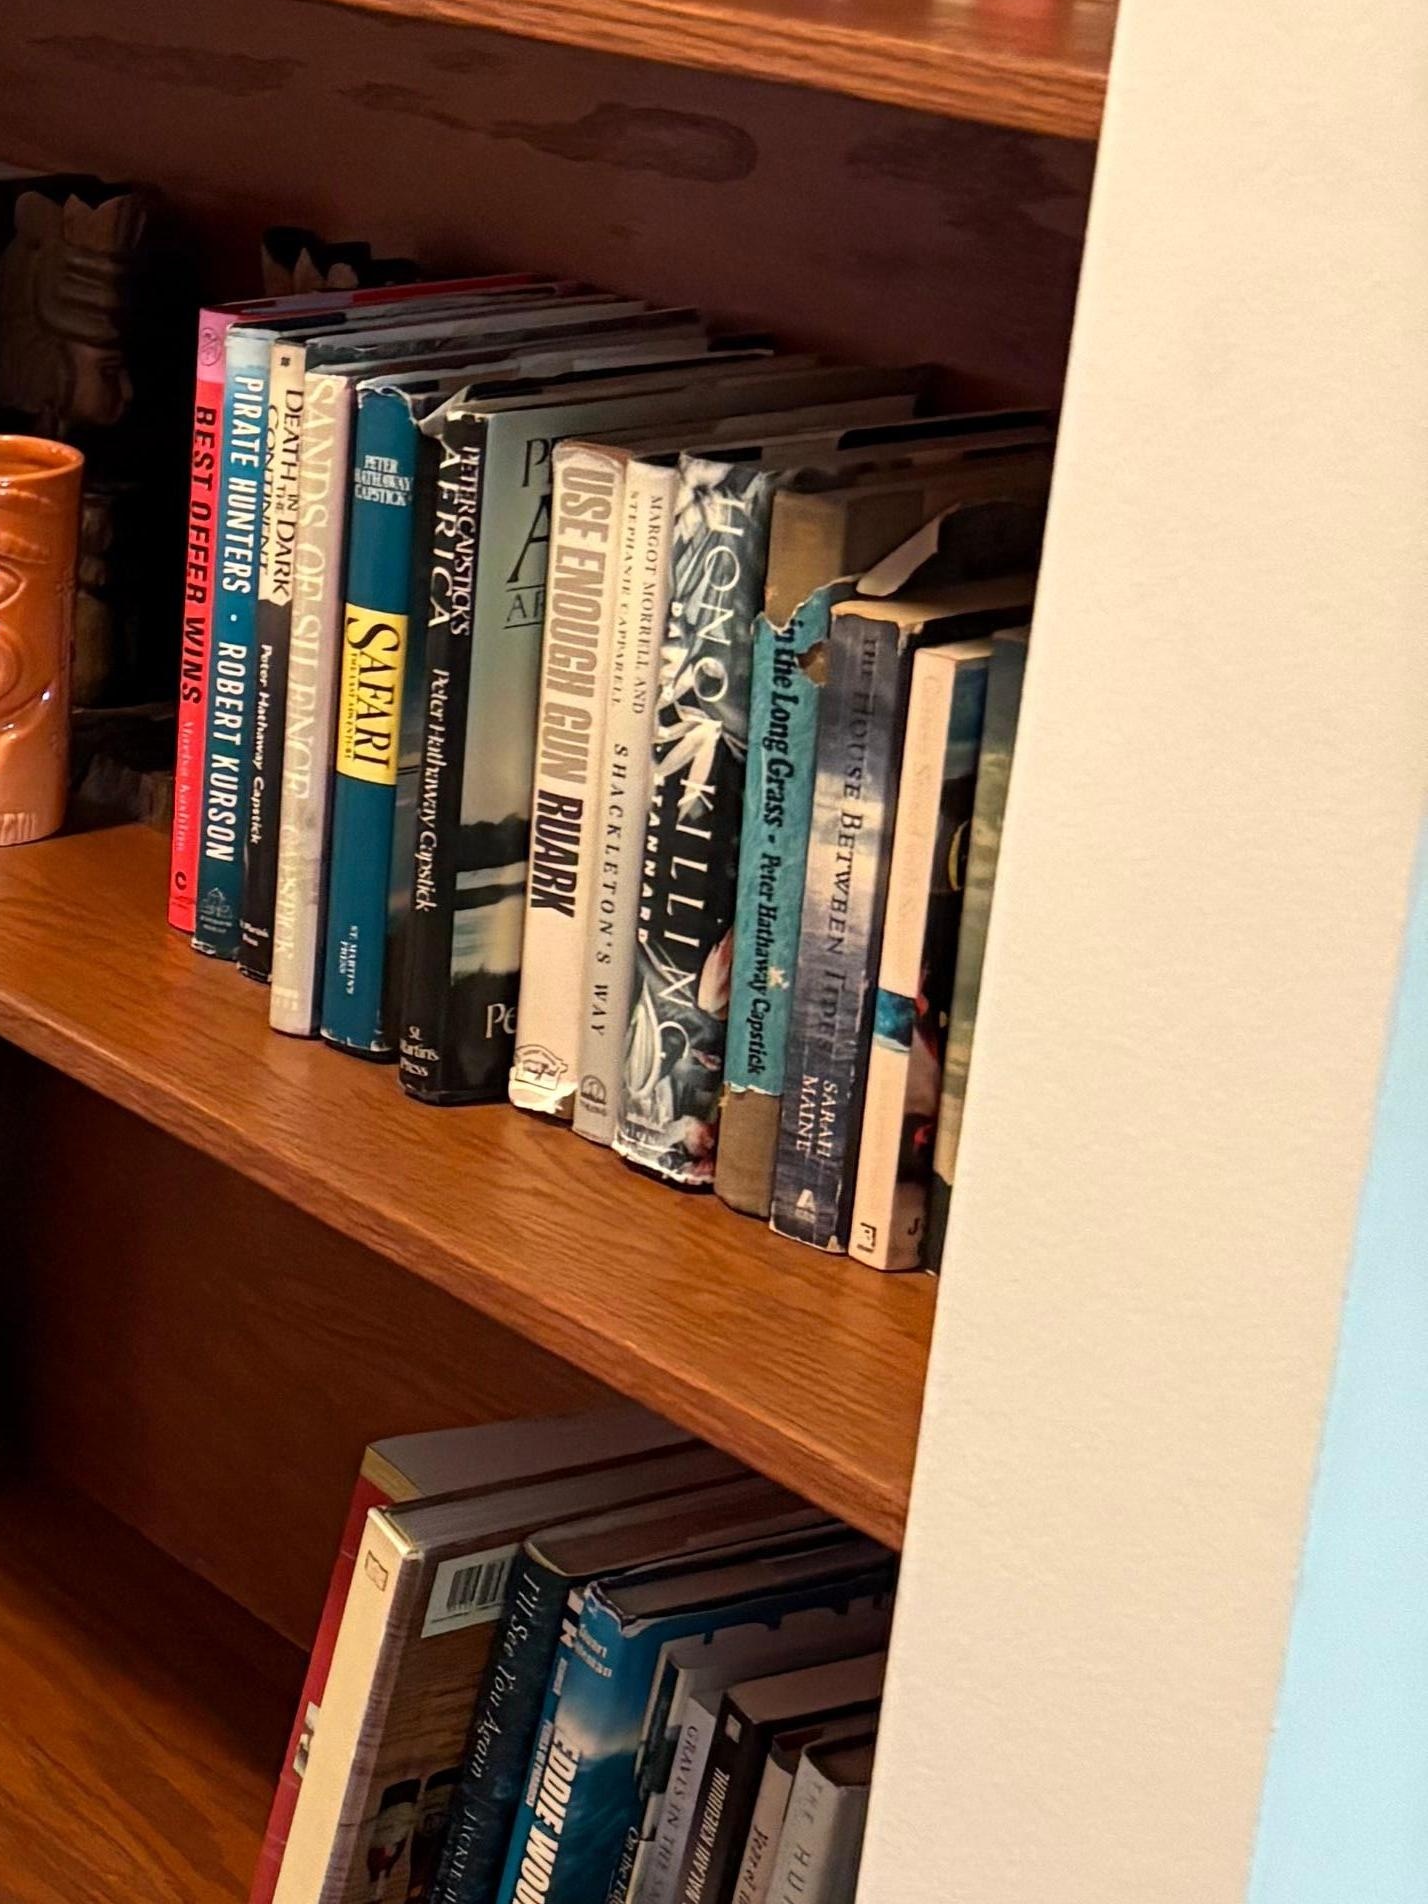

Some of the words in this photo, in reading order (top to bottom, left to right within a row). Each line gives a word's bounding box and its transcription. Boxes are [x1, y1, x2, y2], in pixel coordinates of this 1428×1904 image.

[191, 403, 218, 491] BEST
[230, 374, 264, 471] PIRATE
[285, 388, 305, 485] DEATH
[300, 374, 336, 537] SANDS
[222, 474, 257, 594] HUNTERS
[426, 448, 462, 629] AFRICA
[556, 465, 615, 546] USE
[646, 493, 665, 567] MARGOT
[186, 499, 215, 607] OFFER
[275, 515, 298, 598] DARK
[294, 541, 326, 588] OF
[180, 615, 207, 706] WINS
[259, 643, 274, 691] Peter
[545, 546, 608, 702] ENOUGH
[773, 643, 803, 683] the
[210, 641, 248, 747] ROBERT
[254, 693, 270, 769] Hathaway
[285, 590, 323, 803] SILENCE
[346, 615, 401, 771] SAFARI
[429, 666, 452, 715] Peter
[763, 682, 801, 759] Long
[539, 703, 593, 785] GUN
[205, 753, 242, 864] KURSON
[249, 771, 266, 844] Capstick
[763, 758, 797, 829] Grass
[414, 817, 439, 913] Capstick
[529, 788, 585, 921] RUARK
[597, 741, 631, 966] SHACKLETON'S
[759, 851, 783, 898] Peter
[826, 810, 864, 957] BETWEEN
[752, 898, 778, 988] Hathaway
[591, 979, 611, 1038] WAY
[745, 988, 774, 1078] Capstick
[795, 1073, 819, 1154] MAINE
[815, 1078, 839, 1159] SARAH
[505, 1618, 531, 1659] See
[493, 1664, 519, 1711] You
[470, 1708, 503, 1781] Again
[534, 1734, 582, 1836] EDDIE
